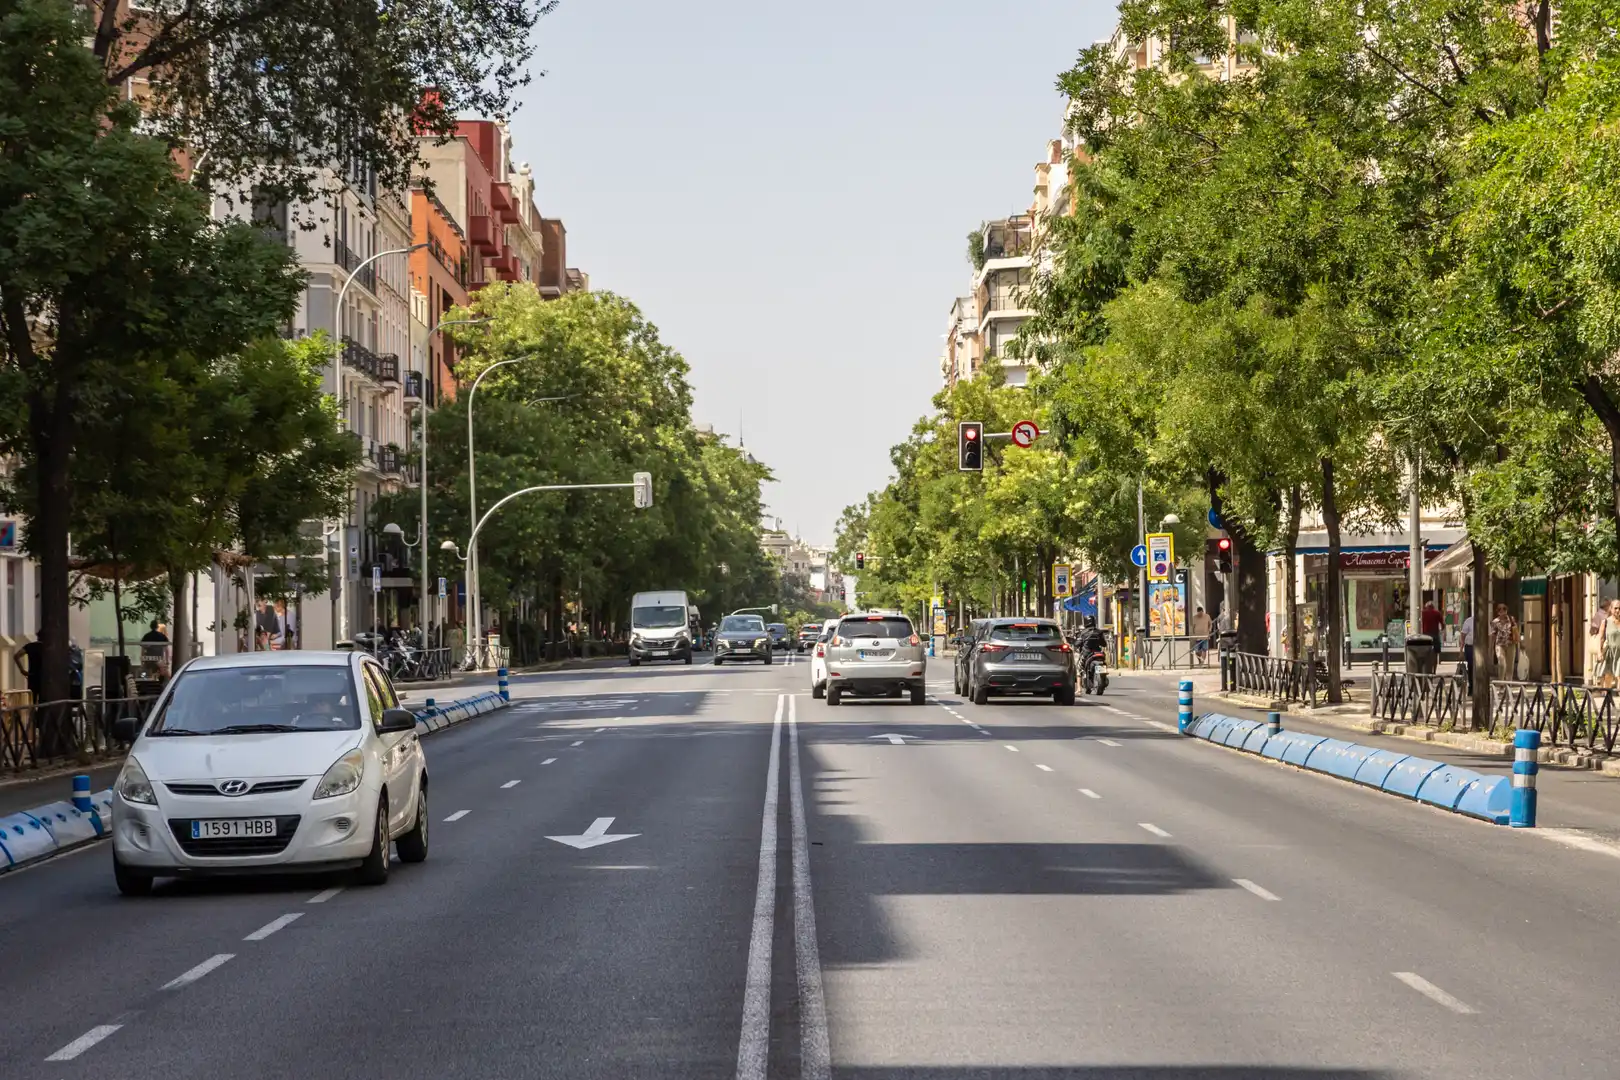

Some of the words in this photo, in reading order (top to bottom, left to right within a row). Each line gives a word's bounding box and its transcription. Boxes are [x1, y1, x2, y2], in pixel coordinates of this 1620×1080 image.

[1345, 553, 1386, 566] Almacenes
[204, 822, 238, 836] 1591
[244, 820, 273, 835] HBB
